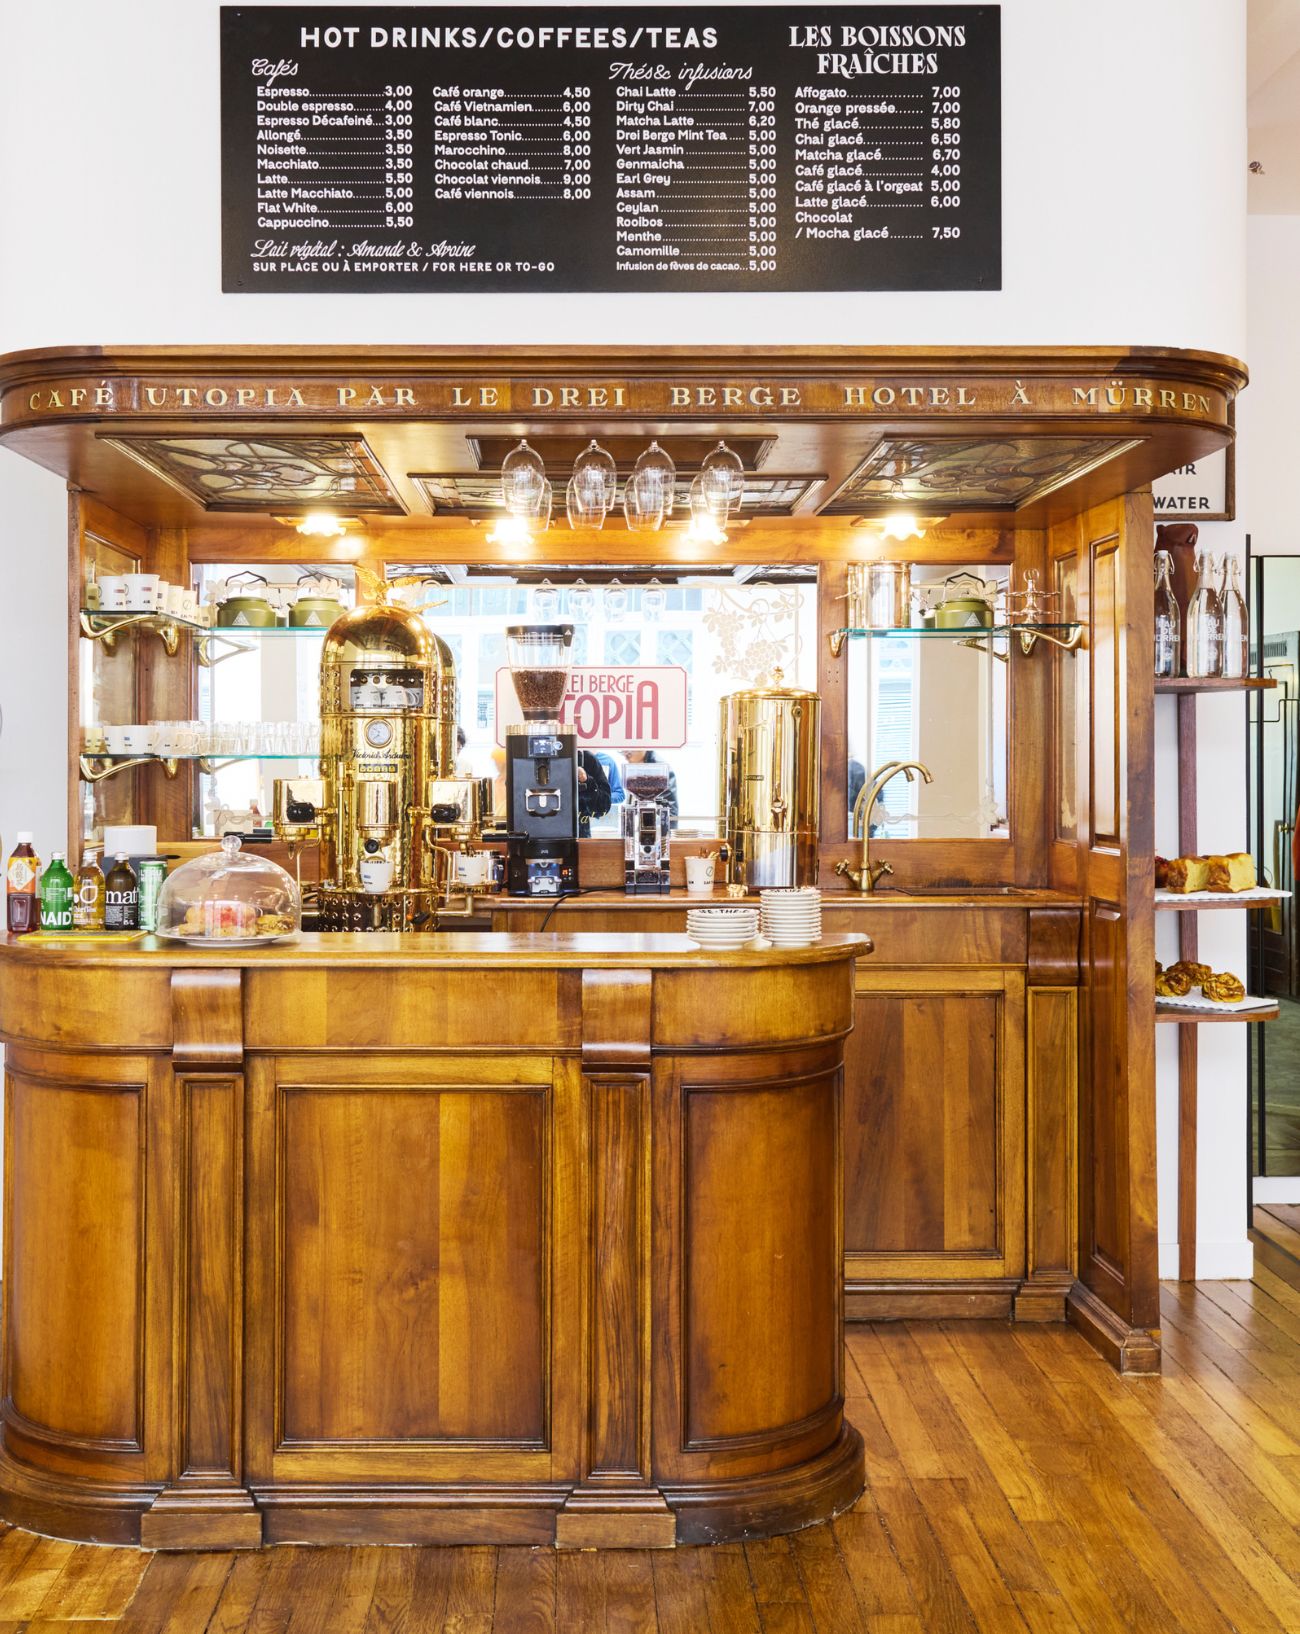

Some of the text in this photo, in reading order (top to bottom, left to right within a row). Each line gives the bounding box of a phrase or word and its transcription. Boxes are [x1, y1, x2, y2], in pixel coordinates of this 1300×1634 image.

[300, 26, 718, 48] HOT DRINKS/COFFEES/TEAS
[788, 25, 966, 48] LES BOISSONS
[816, 47, 938, 79] FRAÎCHES
[251, 58, 299, 87] Cafés
[677, 62, 752, 91] infusions
[257, 85, 413, 99] Espresso 3,00
[433, 86, 591, 100] Café orange 4,50
[616, 86, 776, 99] Chai Latte 5,50
[795, 86, 960, 101] Affogato 7,00
[257, 100, 413, 114] Double espresso 4,00
[434, 100, 591, 114] Café Vietnamien 6,00
[616, 100, 775, 114] Dirty Chai 7,00
[795, 101, 960, 116] Orange pressée 7,00
[257, 115, 310, 128] Espresso
[385, 114, 413, 127] 3,00
[434, 114, 591, 128] Café blanc 4,50
[616, 115, 776, 128] Matcha Latte 6,20
[794, 117, 960, 132] Thé glacé 5,80
[256, 129, 413, 143] Allongé 3,50
[434, 130, 591, 143] Espresso Tonic 6,00
[616, 129, 776, 143] Drei Berge Mint Tea 5,00
[795, 132, 960, 148] Chai glacé 6,50
[257, 143, 413, 156] Noisette 3,50
[435, 144, 591, 157] Marocchino 8,00
[616, 144, 776, 157] Vert Jasmin 5,00
[795, 148, 960, 163] Matcha glacé 6,70
[257, 158, 413, 171] Macchiato 3,50
[435, 159, 591, 172] Chocolat chaud 7,00
[616, 158, 776, 171] Genmaicha 5,00
[795, 163, 960, 179] Café glacé 4,00
[257, 172, 413, 185] Latte 5,50
[435, 173, 591, 186] Chocolat viennois 9,00
[616, 173, 776, 186] Earl Grey 5,00
[257, 187, 413, 200] Latte Macchiato 5,00
[435, 187, 591, 201] Café viennois 8,00
[616, 187, 777, 200] Assam 5,00
[795, 179, 824, 192] Café
[826, 179, 862, 195] glacé
[864, 179, 874, 192] à
[931, 180, 960, 193] 5,00
[257, 201, 413, 214] Flat White 6,00
[616, 201, 777, 215] Ceylan 5,00
[795, 195, 960, 210] Latte glacé 6,00
[257, 216, 413, 230] Cappuccino 5,50
[616, 216, 777, 229] Rooibos 5,00
[795, 211, 853, 223] Chocolat
[616, 231, 777, 245] Menthe 5,00
[806, 227, 851, 239] Mocha
[853, 226, 889, 241] glacé
[932, 227, 960, 240] 7,50
[250, 239, 289, 258] Lait
[289, 239, 338, 260] végétal
[346, 239, 405, 258] Amande
[406, 241, 423, 257] &
[425, 239, 476, 258] Avoine
[616, 245, 777, 259] Camomille 5,00
[253, 262, 277, 272] SUR
[281, 262, 319, 272] PLACE
[322, 262, 339, 272] OU
[343, 259, 351, 272] À
[354, 262, 419, 272] EMPORTER
[432, 262, 456, 272] FOR
[459, 262, 492, 272] HERE
[496, 262, 512, 272] OR
[515, 262, 555, 272] TO-GO
[616, 259, 777, 274] Infusion de fèves de cacao 5,00
[28, 380, 114, 410] CAFÉ
[145, 387, 308, 407] UTOPIA
[452, 387, 500, 406] LE
[531, 387, 626, 407] DREI
[670, 386, 802, 406] BERGE
[843, 386, 976, 406] HOTEL
[1010, 379, 1032, 406] À
[1072, 380, 1211, 414] MÜRREN
[1153, 496, 1211, 509] WATER
[589, 674, 635, 693] BERGE
[558, 680, 659, 740] TOPIA
